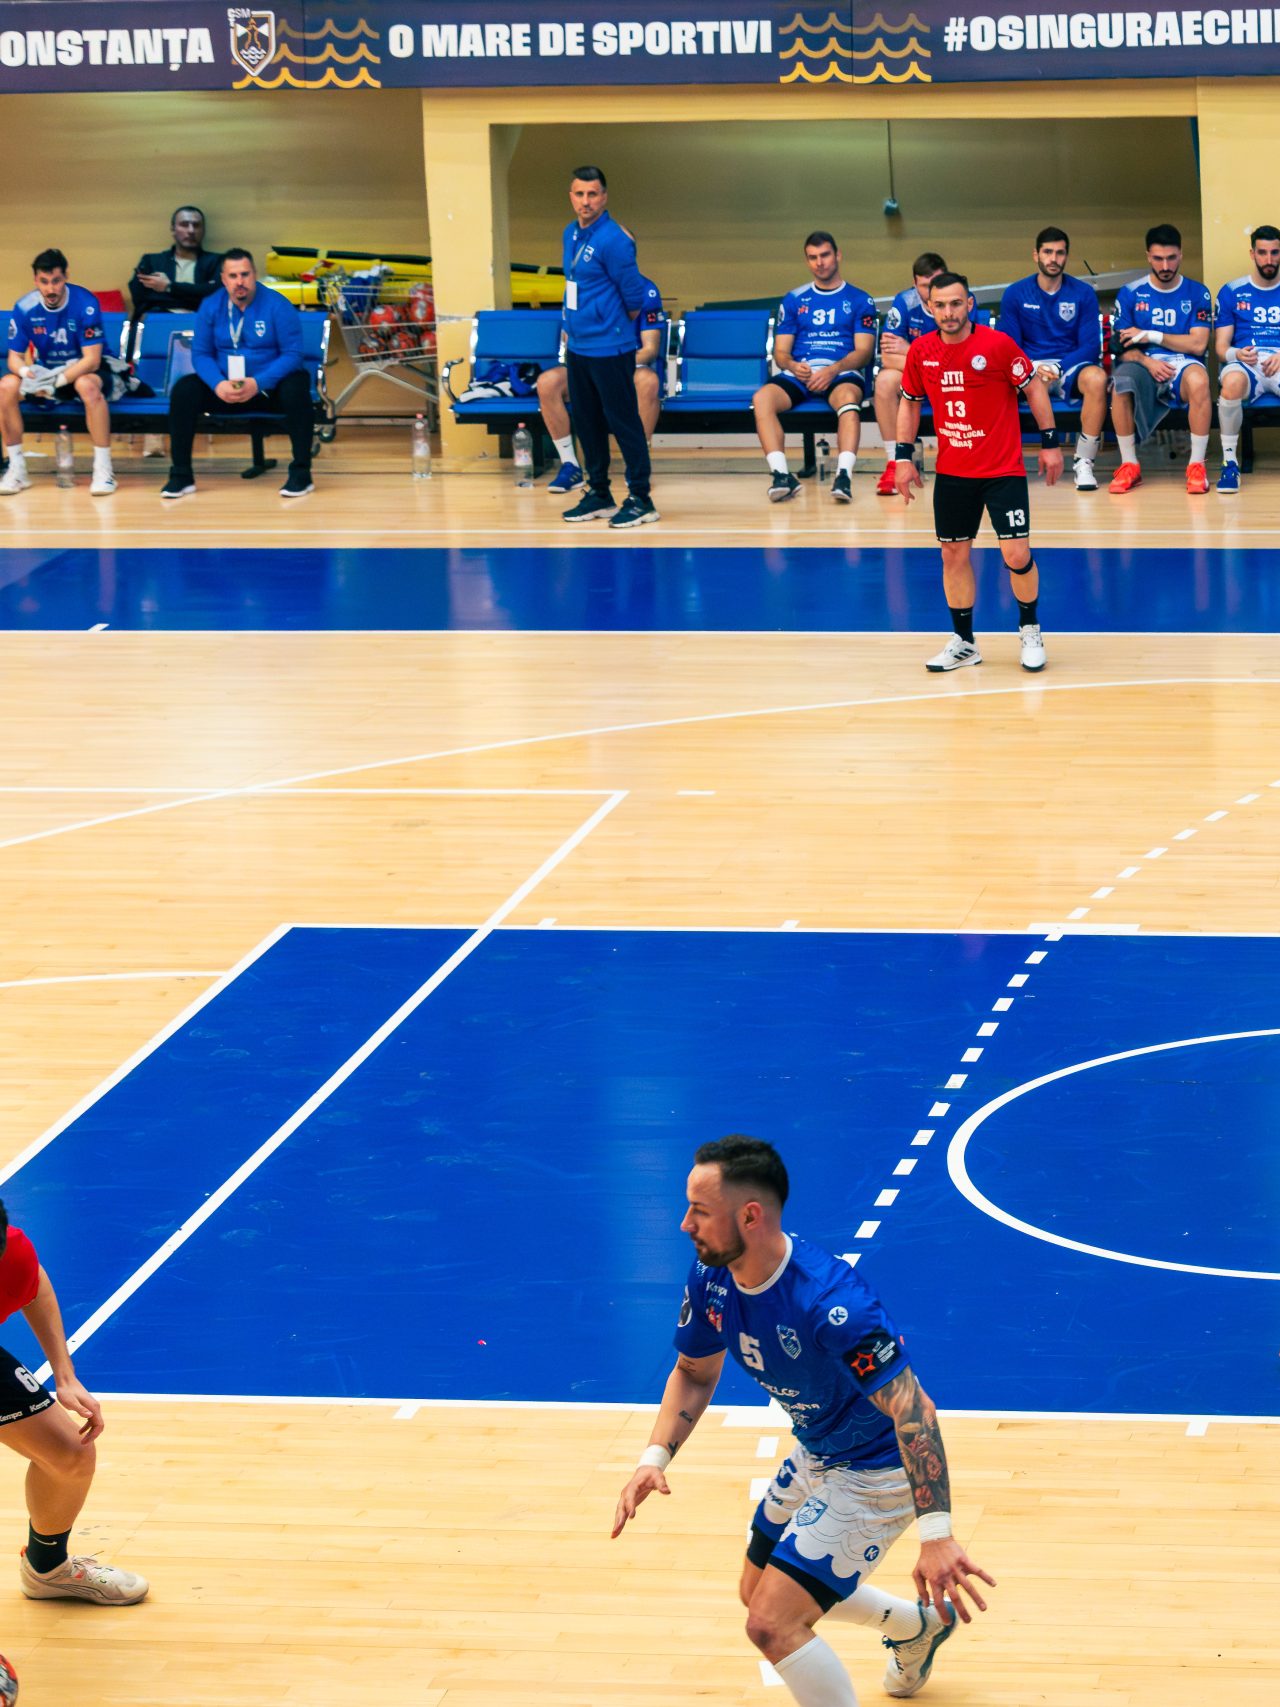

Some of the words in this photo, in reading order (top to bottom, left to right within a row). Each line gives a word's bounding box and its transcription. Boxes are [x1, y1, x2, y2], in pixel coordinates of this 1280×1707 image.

[388, 24, 415, 59] O
[422, 22, 531, 58] MARE
[538, 22, 585, 57] DE
[592, 20, 773, 57] SPORTIVI
[812, 308, 836, 325] 31
[1152, 308, 1176, 327] 20
[1253, 306, 1280, 323] 33
[941, 371, 964, 385] JTTI
[945, 401, 966, 418] 13
[962, 429, 986, 439] LOCAL
[1005, 509, 1026, 527] 13
[739, 1332, 765, 1371] 5
[15, 1366, 40, 1393] 6
